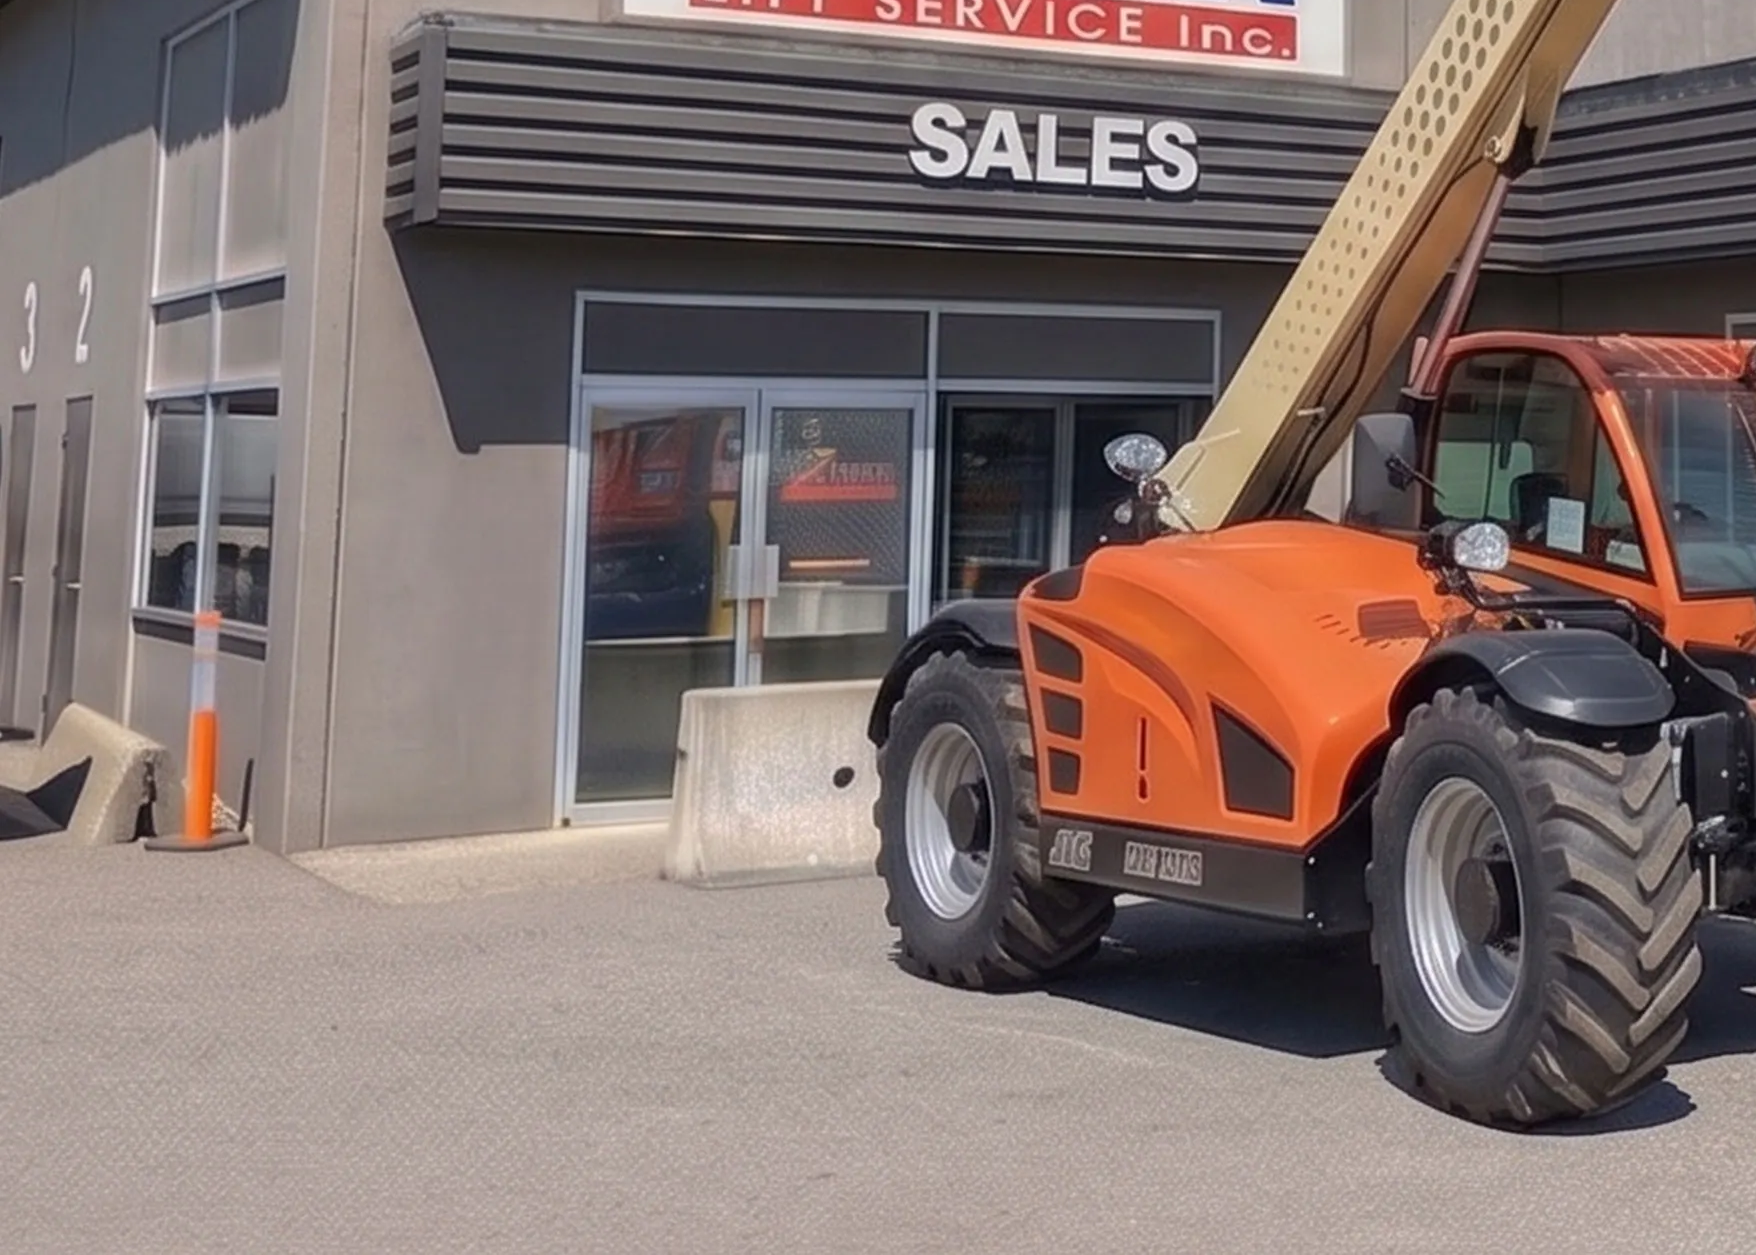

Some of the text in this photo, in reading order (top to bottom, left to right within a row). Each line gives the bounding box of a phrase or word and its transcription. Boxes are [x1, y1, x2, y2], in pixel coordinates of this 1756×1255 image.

[1178, 13, 1293, 58] Inc.
[908, 101, 1198, 192] SALES
[20, 280, 37, 374] 3
[75, 265, 93, 364] 2
